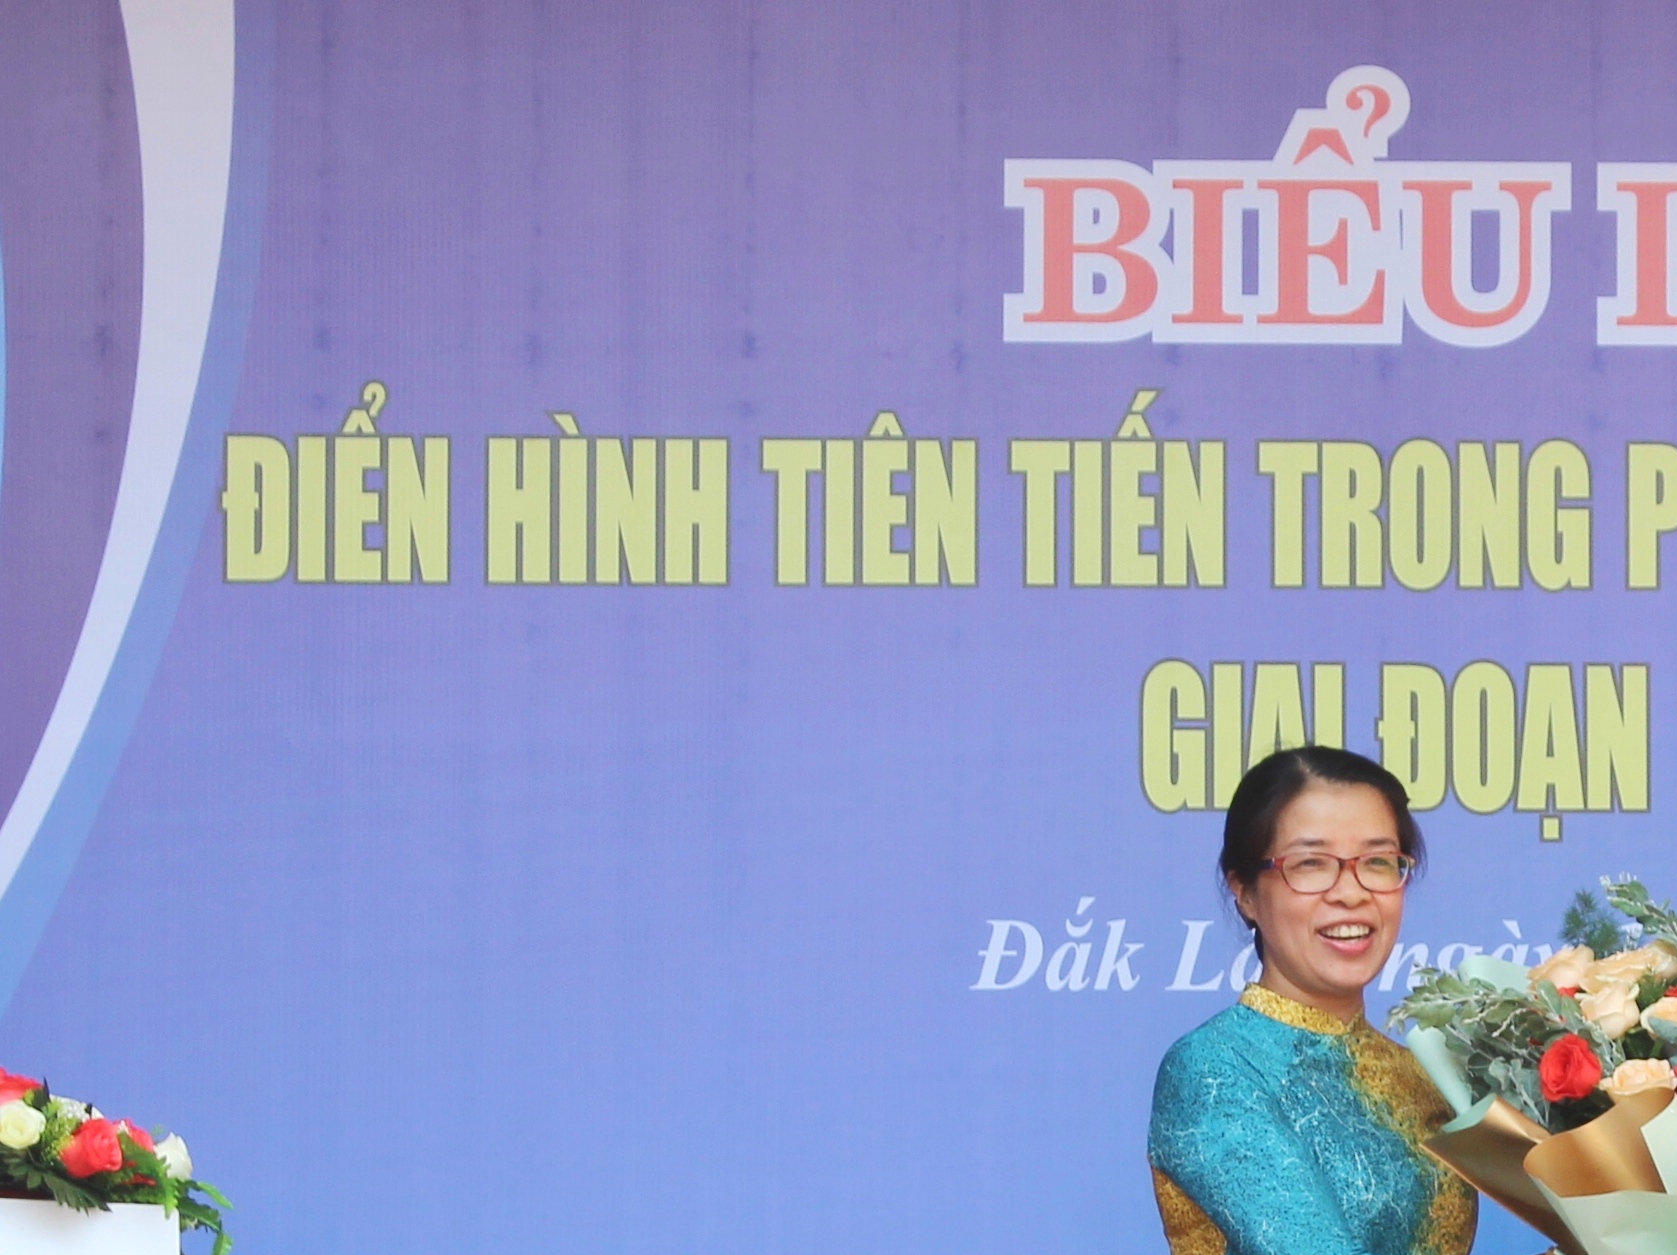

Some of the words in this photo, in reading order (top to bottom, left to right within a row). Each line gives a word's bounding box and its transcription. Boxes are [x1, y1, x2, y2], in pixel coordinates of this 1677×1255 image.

[1022, 83, 1551, 329] BIỂU
[219, 380, 451, 583] ĐIỂN
[484, 411, 731, 586] HÌNH
[759, 410, 980, 587] TIÊN
[1008, 389, 1227, 588] TIẾN
[1257, 437, 1592, 592] TRONG
[1375, 659, 1650, 842] ĐOẠN
[969, 897, 1144, 993] Đắk
